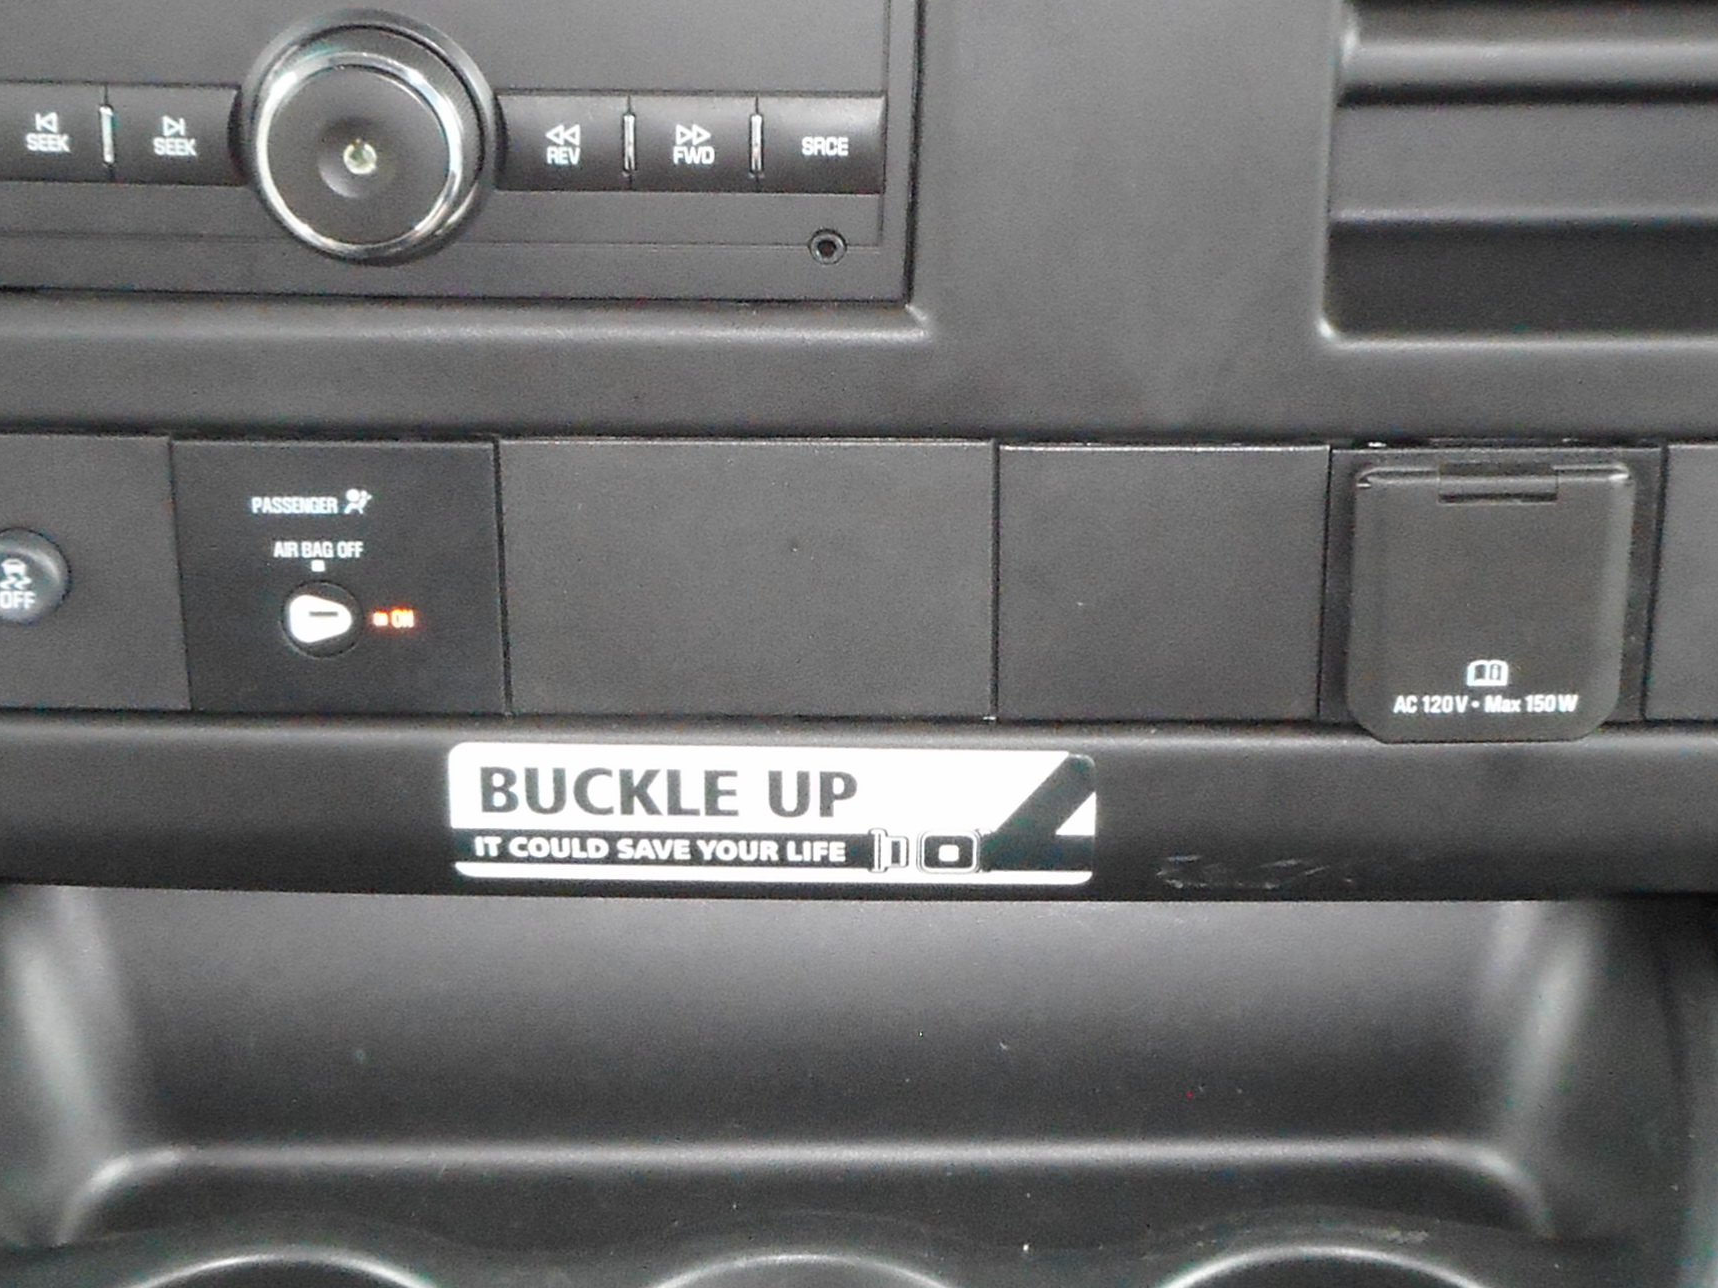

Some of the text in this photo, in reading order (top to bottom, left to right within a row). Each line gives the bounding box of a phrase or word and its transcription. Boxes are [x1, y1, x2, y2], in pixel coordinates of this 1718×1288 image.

[26, 132, 197, 158] SEEK SEEK
[546, 145, 715, 166] REV FWD
[801, 136, 848, 157] SRCE
[251, 495, 338, 515] PASSENGER
[273, 541, 363, 560] AIR BAG OFF
[391, 609, 415, 629] ON
[1393, 696, 1418, 714] AC
[1484, 696, 1522, 714] Max
[479, 765, 859, 820] BUCKLE UP
[474, 836, 848, 864] IT COULD SAVE YOUR LIFE
